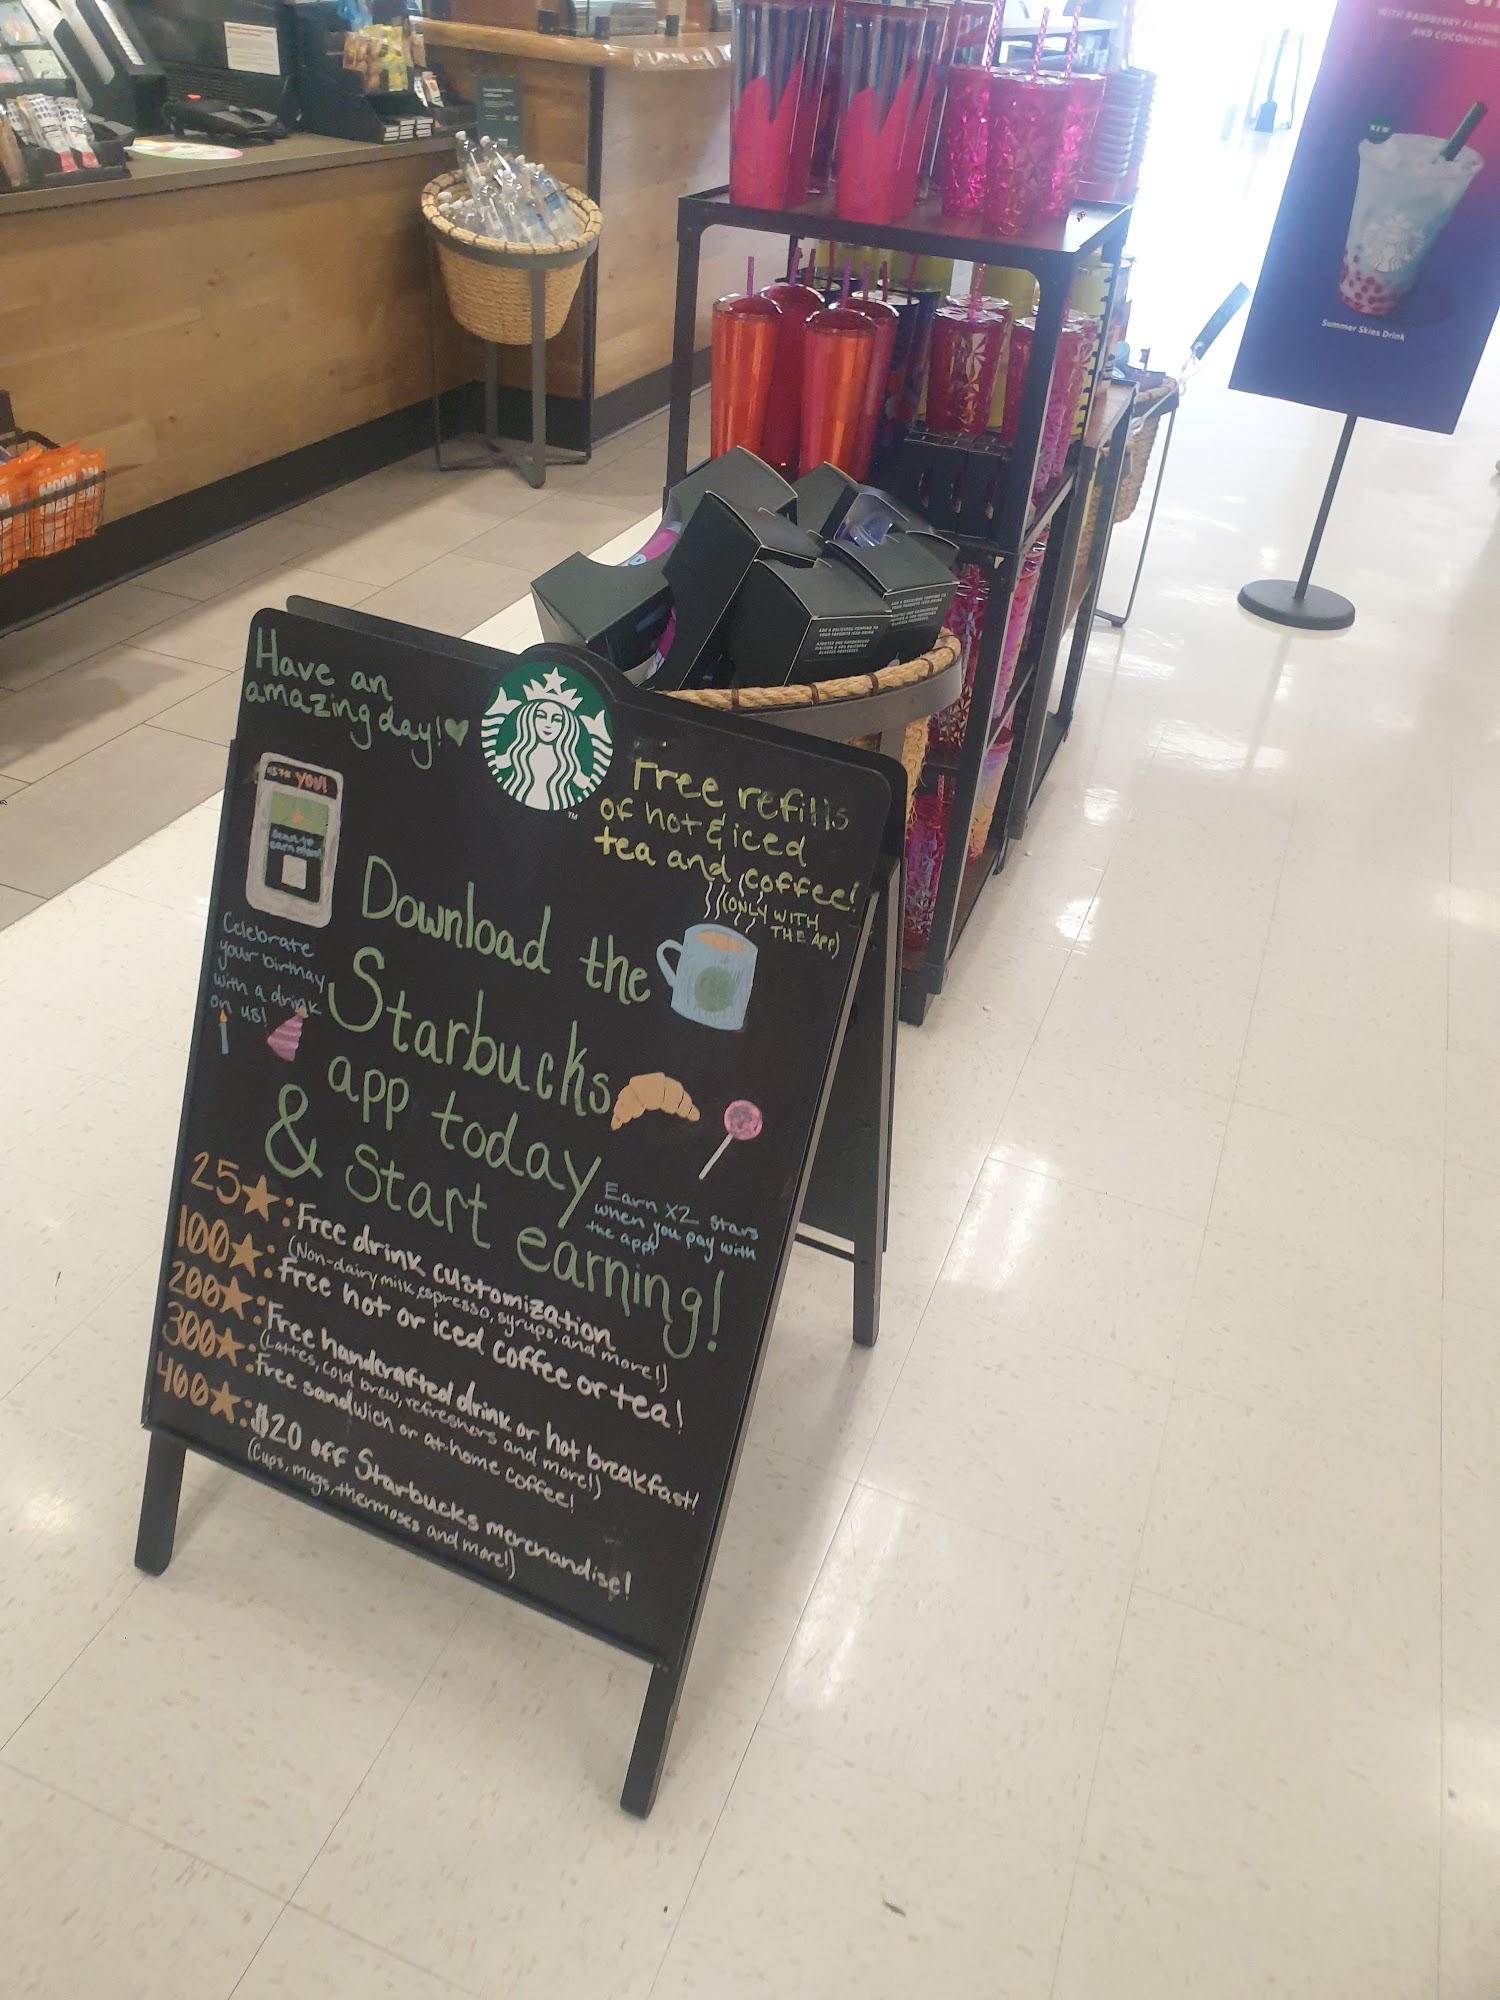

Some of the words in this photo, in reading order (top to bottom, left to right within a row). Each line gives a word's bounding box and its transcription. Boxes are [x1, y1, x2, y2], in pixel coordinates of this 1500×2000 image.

[1322, 319, 1357, 332] Summer
[1358, 326, 1380, 337] Skies
[1382, 330, 1405, 341] Drink
[256, 627, 335, 686] Have
[351, 671, 393, 702] an
[246, 681, 372, 751] amazing
[379, 705, 443, 770] day!
[645, 801, 702, 835] hot
[733, 823, 807, 867] iced
[738, 787, 849, 831] refills
[594, 826, 656, 866] tea
[667, 850, 731, 883] and
[745, 868, 860, 913] coffee!
[223, 912, 315, 957] Celebrate
[361, 855, 551, 975] Download
[579, 934, 650, 1005] the
[770, 925, 806, 943] THE
[774, 910, 819, 931] WITH
[218, 939, 259, 971] your
[211, 995, 232, 1014] on
[241, 1006, 268, 1027] us!
[213, 973, 248, 996] with
[255, 985, 267, 1003] a
[271, 984, 322, 1016] drink
[328, 946, 611, 1117] Starbucks
[328, 1055, 410, 1131] app
[431, 1090, 602, 1229] today
[191, 1152, 241, 1204] 25
[178, 1204, 229, 1263] 100
[264, 1083, 325, 1179] &
[517, 1226, 725, 1359] earning!
[585, 1220, 615, 1240] the
[594, 1203, 645, 1228] when
[651, 1222, 681, 1250] you
[686, 1231, 714, 1263] pay
[720, 1242, 756, 1261] with
[605, 1181, 658, 1213] Earn
[710, 1215, 758, 1240] stars
[169, 1261, 221, 1308] 200
[298, 1202, 346, 1245] Free
[353, 1224, 426, 1278] drink
[433, 1263, 616, 1352] customization
[162, 1301, 216, 1357] 300
[278, 1257, 332, 1298] Free
[343, 1282, 391, 1318] hot
[397, 1307, 426, 1330] or
[433, 1312, 484, 1355] iced
[492, 1340, 572, 1391] coffee
[576, 1375, 608, 1399] or
[610, 1383, 684, 1434] tea!
[498, 1311, 558, 1344] syrups,
[562, 1335, 595, 1358] and
[157, 1351, 208, 1406] 400
[267, 1301, 316, 1349] Free
[321, 1327, 454, 1406] handcrafted
[457, 1381, 512, 1432] drink
[516, 1422, 541, 1441] or
[546, 1421, 581, 1463] hot
[586, 1444, 699, 1515] breakfast!
[256, 1352, 297, 1389] Free
[400, 1423, 418, 1439] or
[506, 1467, 574, 1513] coffee!
[323, 1360, 354, 1388] cold
[360, 1377, 402, 1408] brew,
[406, 1397, 497, 1445] refreshers
[503, 1440, 537, 1466] and
[251, 1402, 302, 1451] $20
[355, 1448, 479, 1532] Starbucks
[335, 1482, 420, 1532] thermoses
[427, 1525, 459, 1550] and
